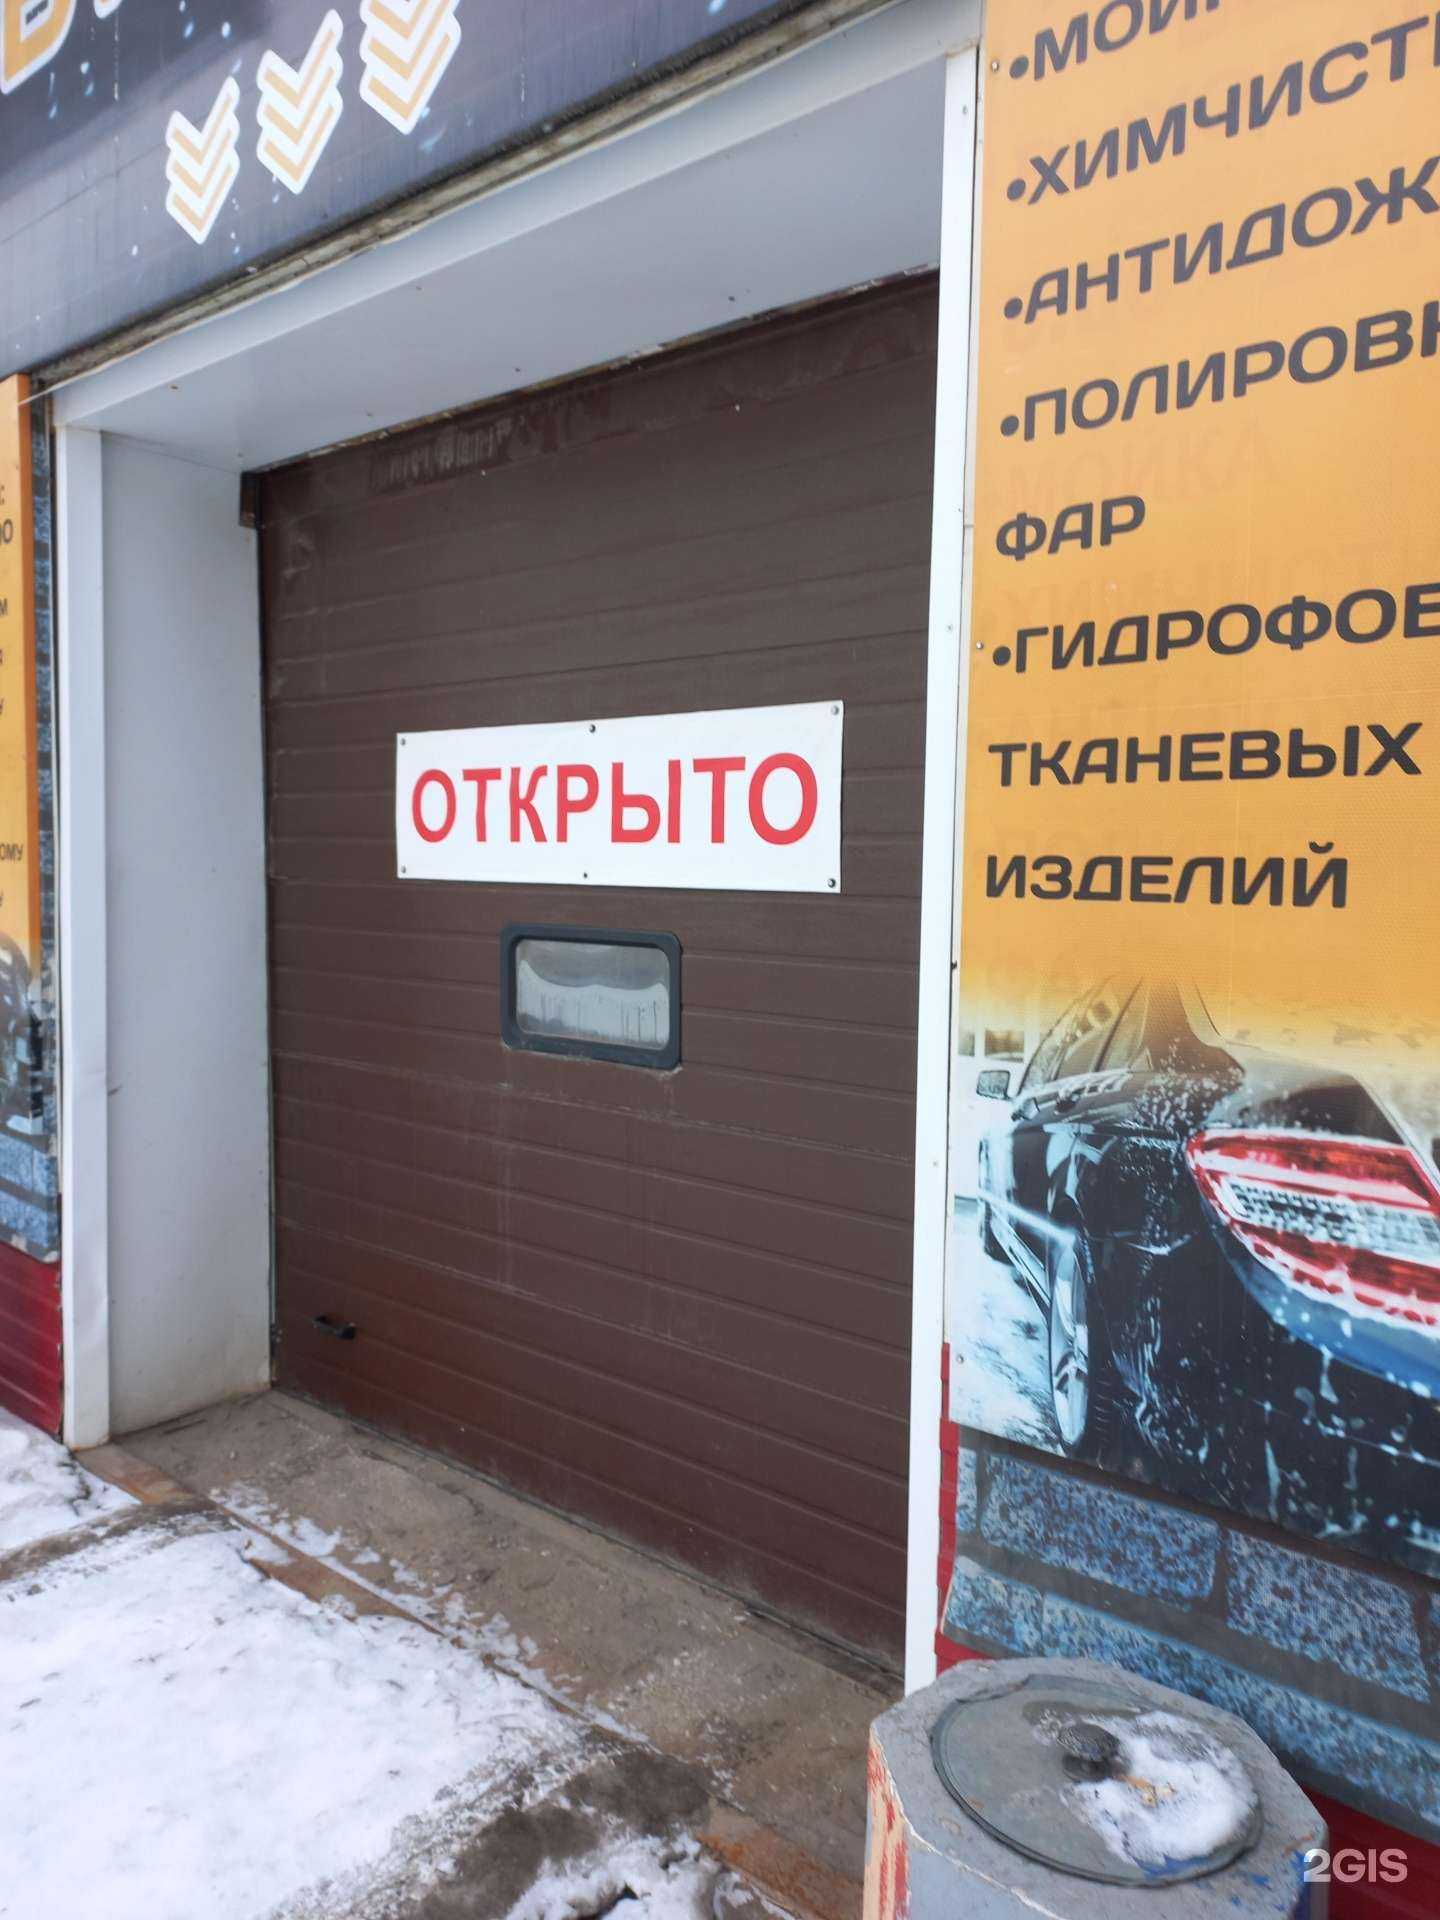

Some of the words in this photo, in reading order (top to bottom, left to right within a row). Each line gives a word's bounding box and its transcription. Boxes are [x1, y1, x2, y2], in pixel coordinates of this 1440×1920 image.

[995, 495, 1146, 561] ФАР
[988, 722, 1423, 787] ТКАНЕВЫХ
[411, 752, 819, 846] ОТКРЫТО
[985, 841, 1348, 909] ИЗДЕЛИЙ
